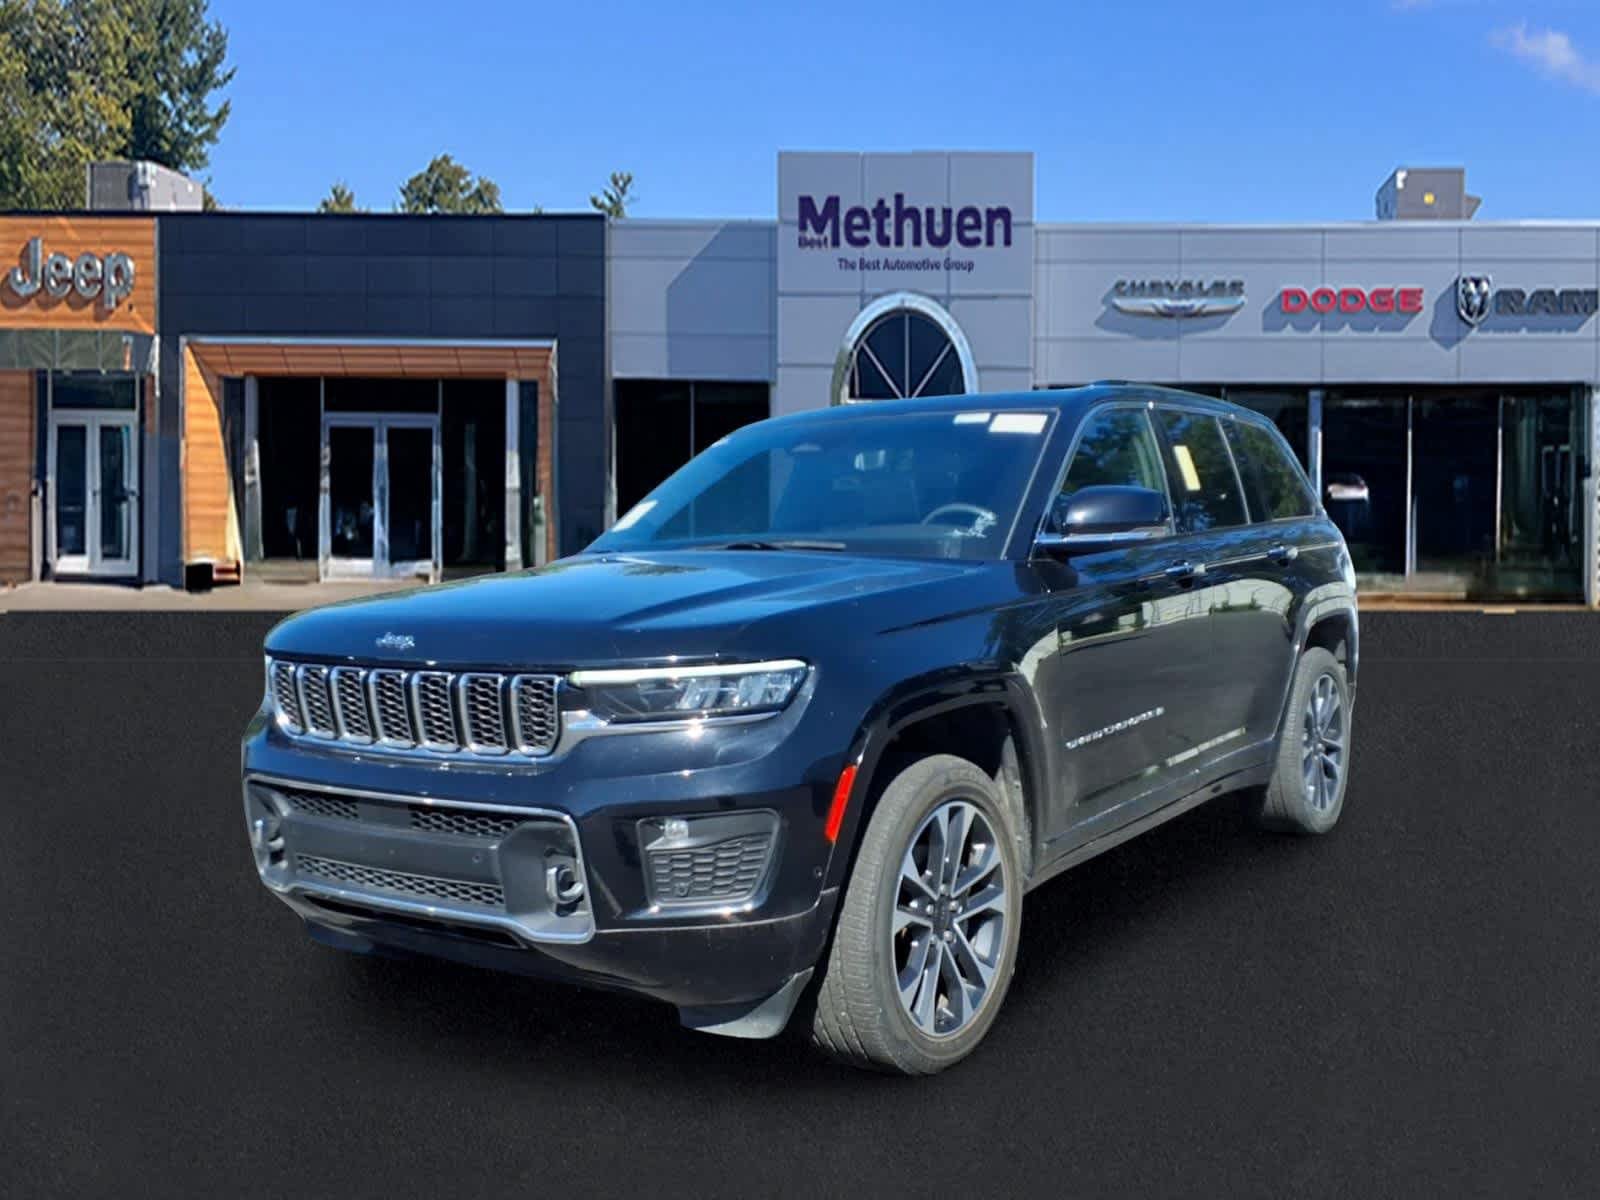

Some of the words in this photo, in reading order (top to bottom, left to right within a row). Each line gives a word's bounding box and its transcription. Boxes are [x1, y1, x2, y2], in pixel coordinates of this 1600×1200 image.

[798, 193, 1012, 248] Methuen
[798, 235, 829, 249] Best
[9, 236, 135, 309] Jeep
[838, 257, 857, 271] The
[859, 257, 881, 271] Best
[883, 257, 941, 271] Automotive
[943, 257, 975, 274] Group
[1280, 288, 1424, 313] DODGE
[1495, 289, 1598, 315] RAM
